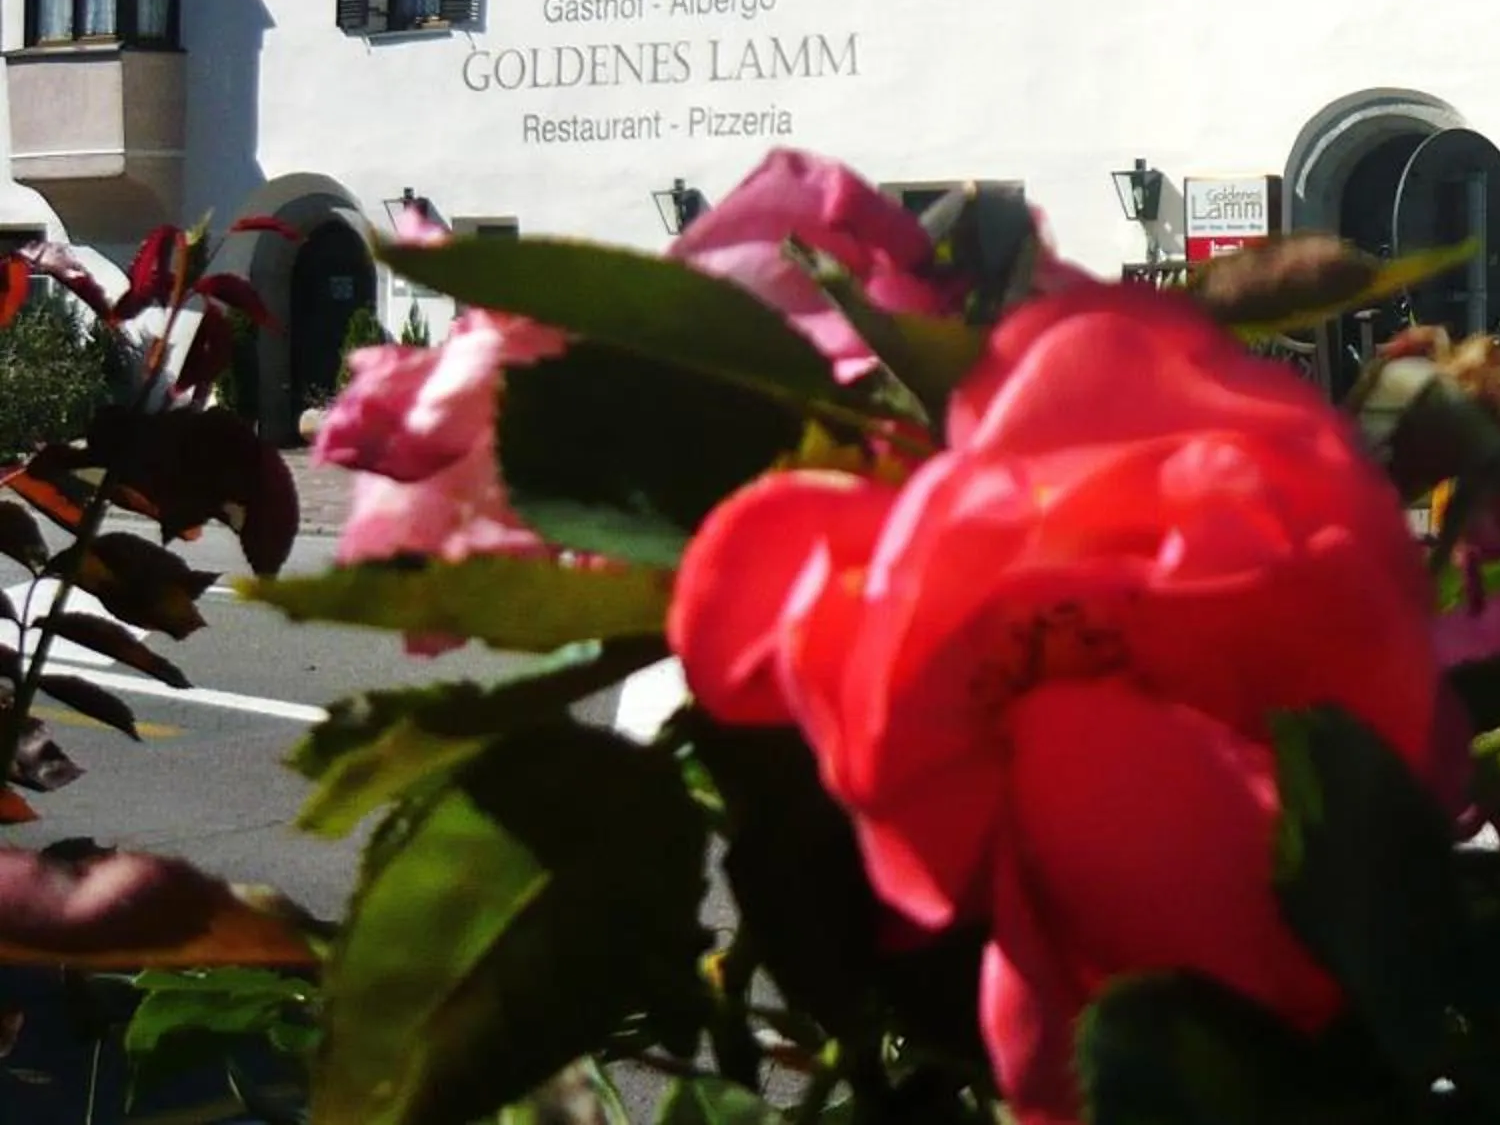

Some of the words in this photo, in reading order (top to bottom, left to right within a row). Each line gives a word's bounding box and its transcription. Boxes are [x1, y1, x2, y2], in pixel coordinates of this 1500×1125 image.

[463, 41, 691, 91] GOLDENES
[709, 33, 861, 81] LAMM
[523, 109, 661, 143] Restaurant
[689, 105, 792, 137] Pizzeria
[1192, 195, 1263, 220] Lamm
